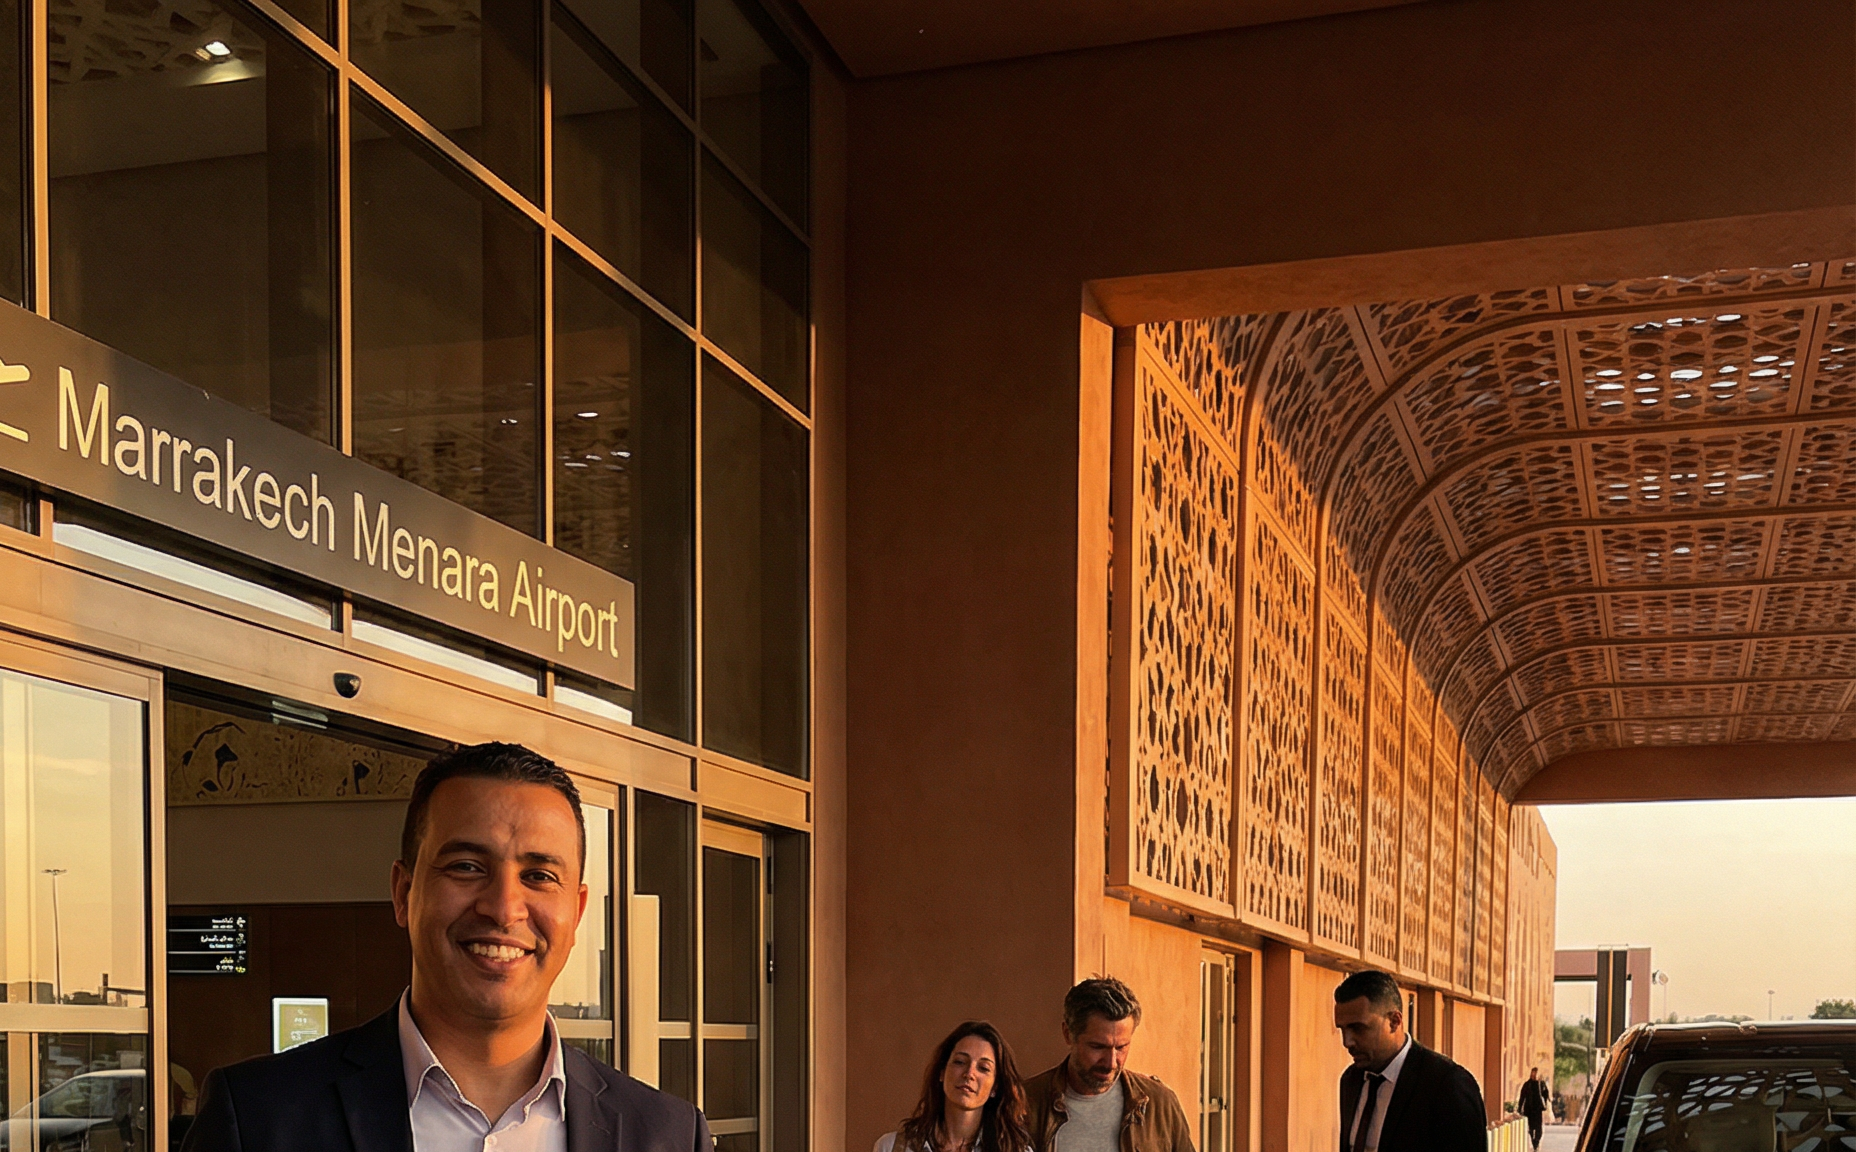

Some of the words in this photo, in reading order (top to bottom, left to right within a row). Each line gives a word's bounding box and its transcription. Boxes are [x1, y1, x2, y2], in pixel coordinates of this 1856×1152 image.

[58, 366, 336, 551] Marrakech
[353, 491, 500, 613] Menara
[509, 560, 620, 659] Airport
